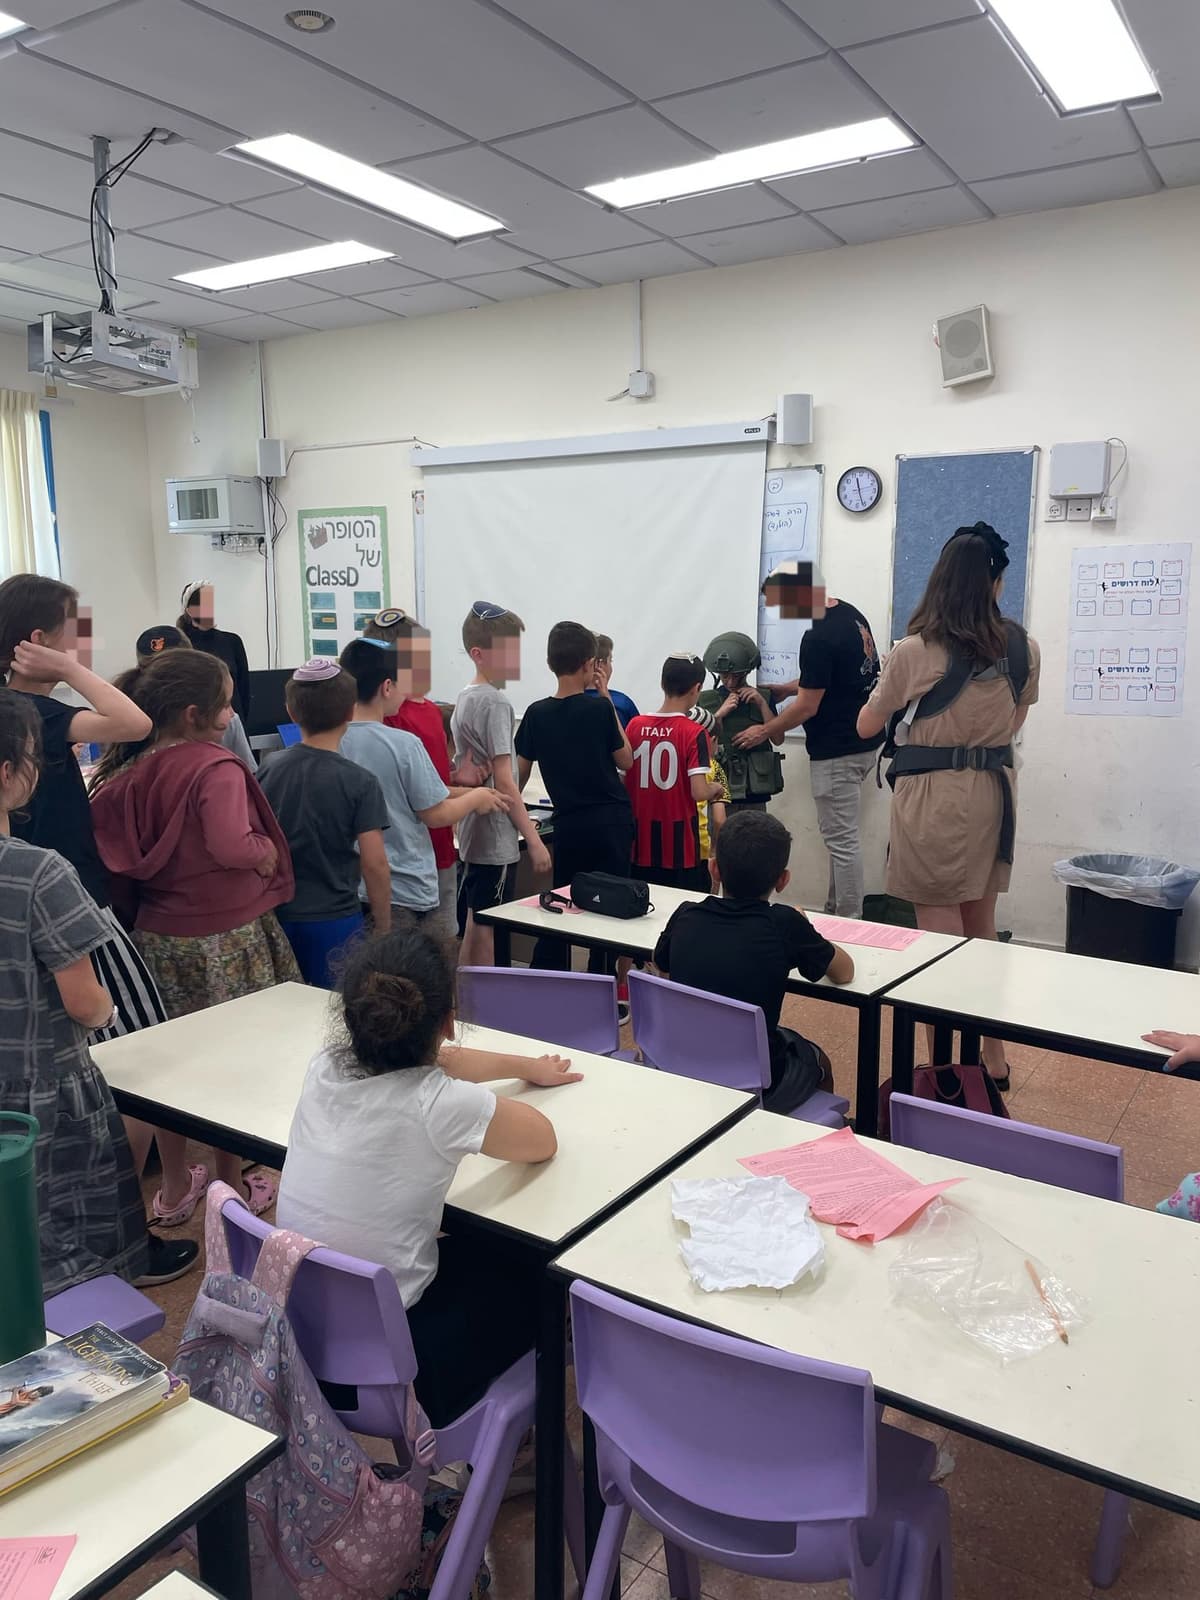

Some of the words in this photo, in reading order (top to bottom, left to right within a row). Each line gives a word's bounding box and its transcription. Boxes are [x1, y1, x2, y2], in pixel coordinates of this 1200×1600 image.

[325, 520, 376, 539] הסופר
[355, 543, 381, 567] של
[305, 564, 359, 587] ClassD
[1111, 580, 1139, 588] דרושים
[1141, 578, 1155, 587] לוח
[1137, 665, 1150, 673] לוח
[641, 726, 673, 737] ITALY
[633, 740, 678, 790] 10
[78, 1371, 113, 1394] THIEF
